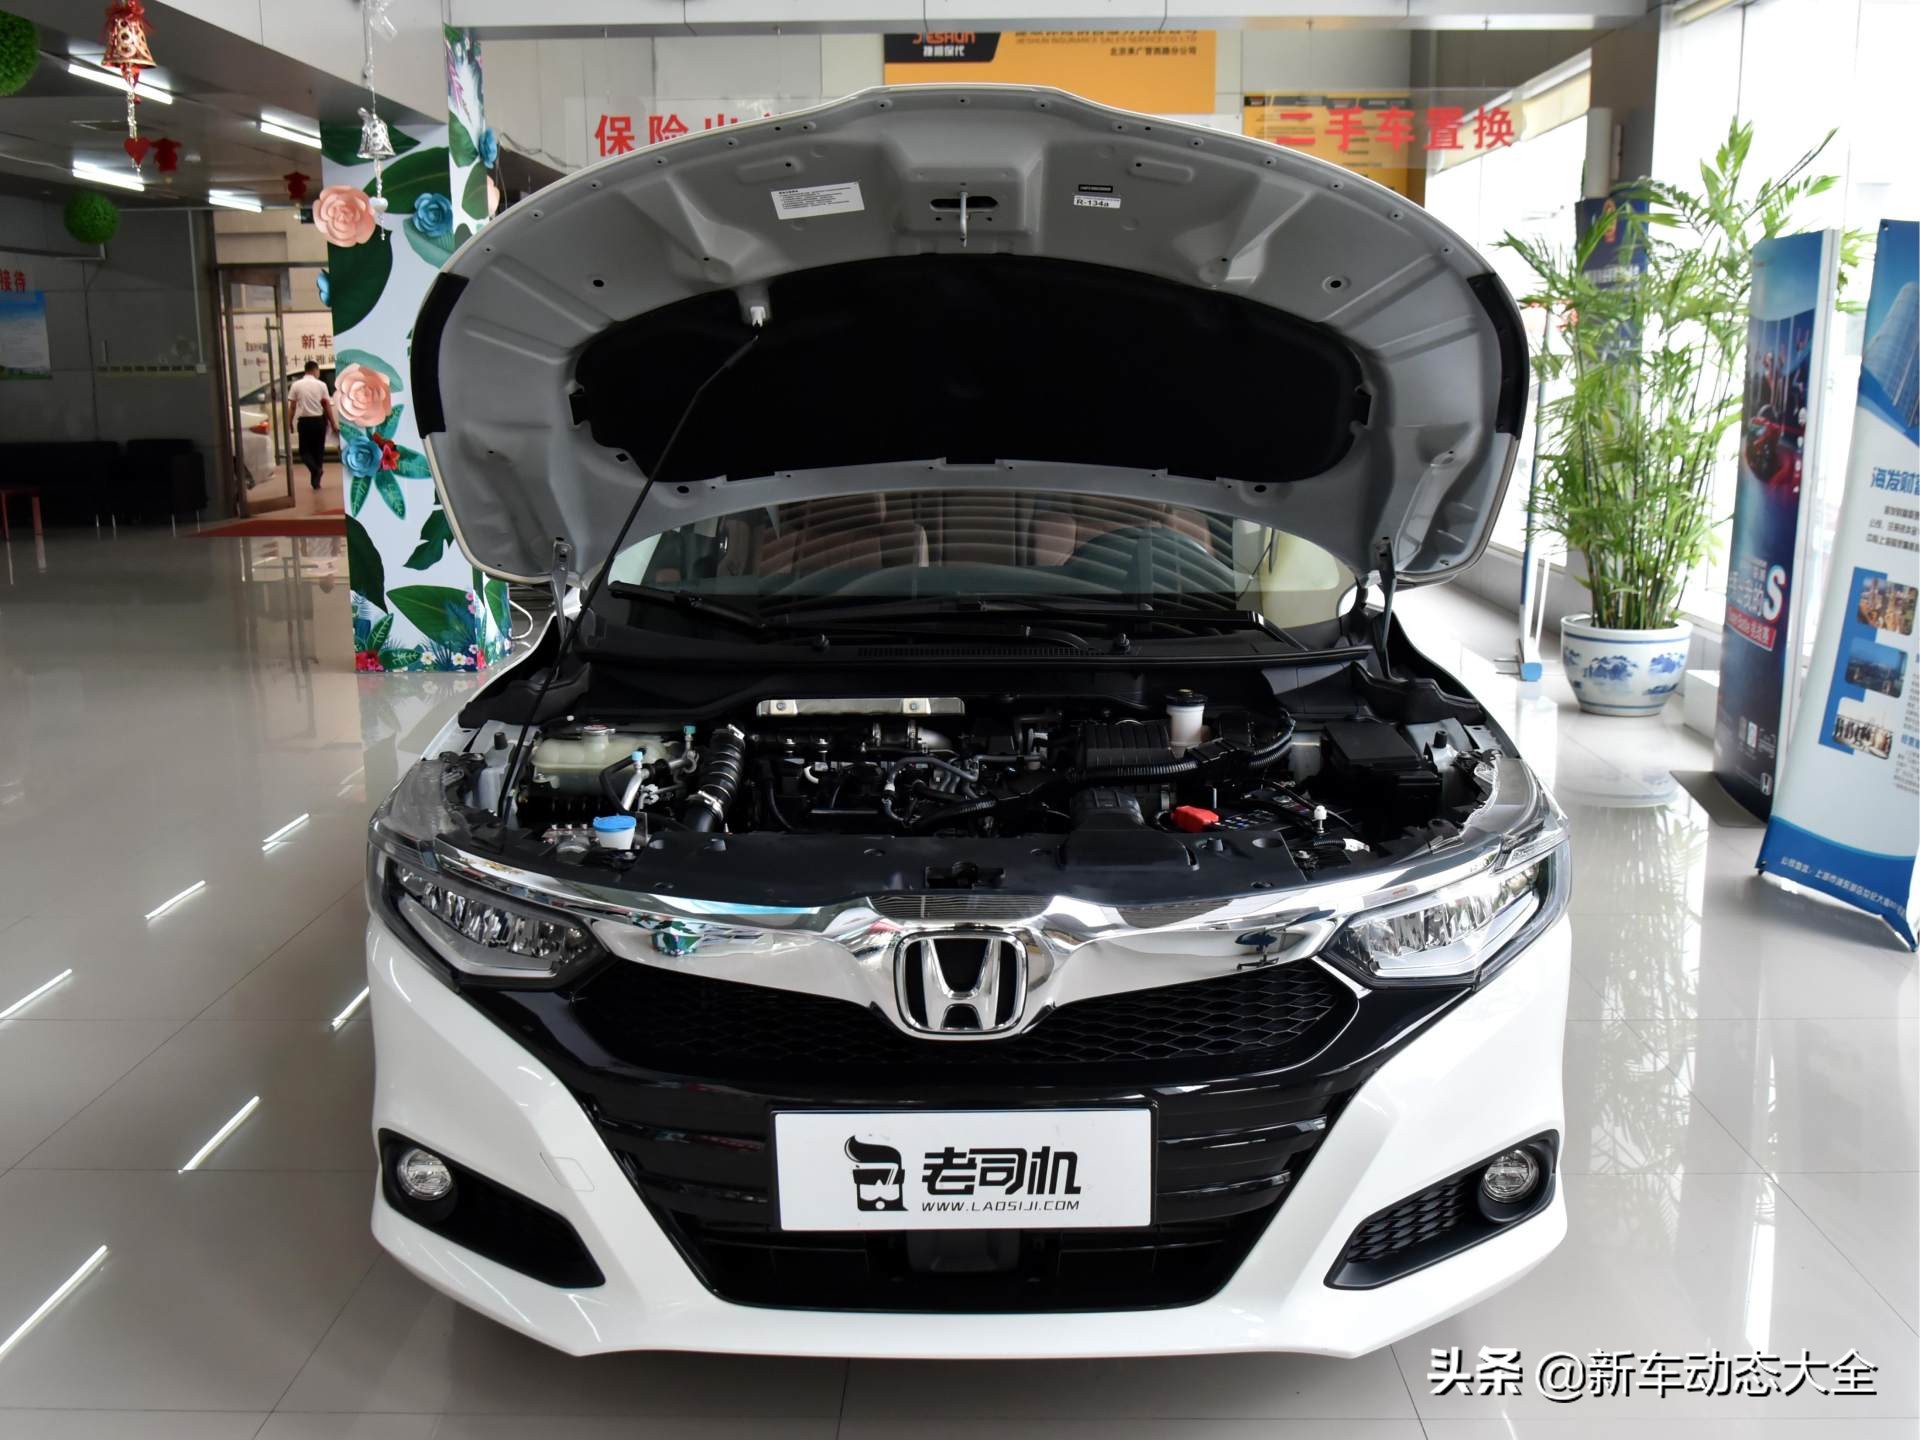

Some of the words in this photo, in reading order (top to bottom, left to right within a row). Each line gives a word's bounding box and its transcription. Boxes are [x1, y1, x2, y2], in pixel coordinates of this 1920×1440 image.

[1276, 106, 1516, 151] 二手车置换
[301, 333, 333, 349] 新车
[921, 1145, 1082, 1196] 老司机
[921, 1200, 1081, 1212] WWW.LAOSIJI.COM
